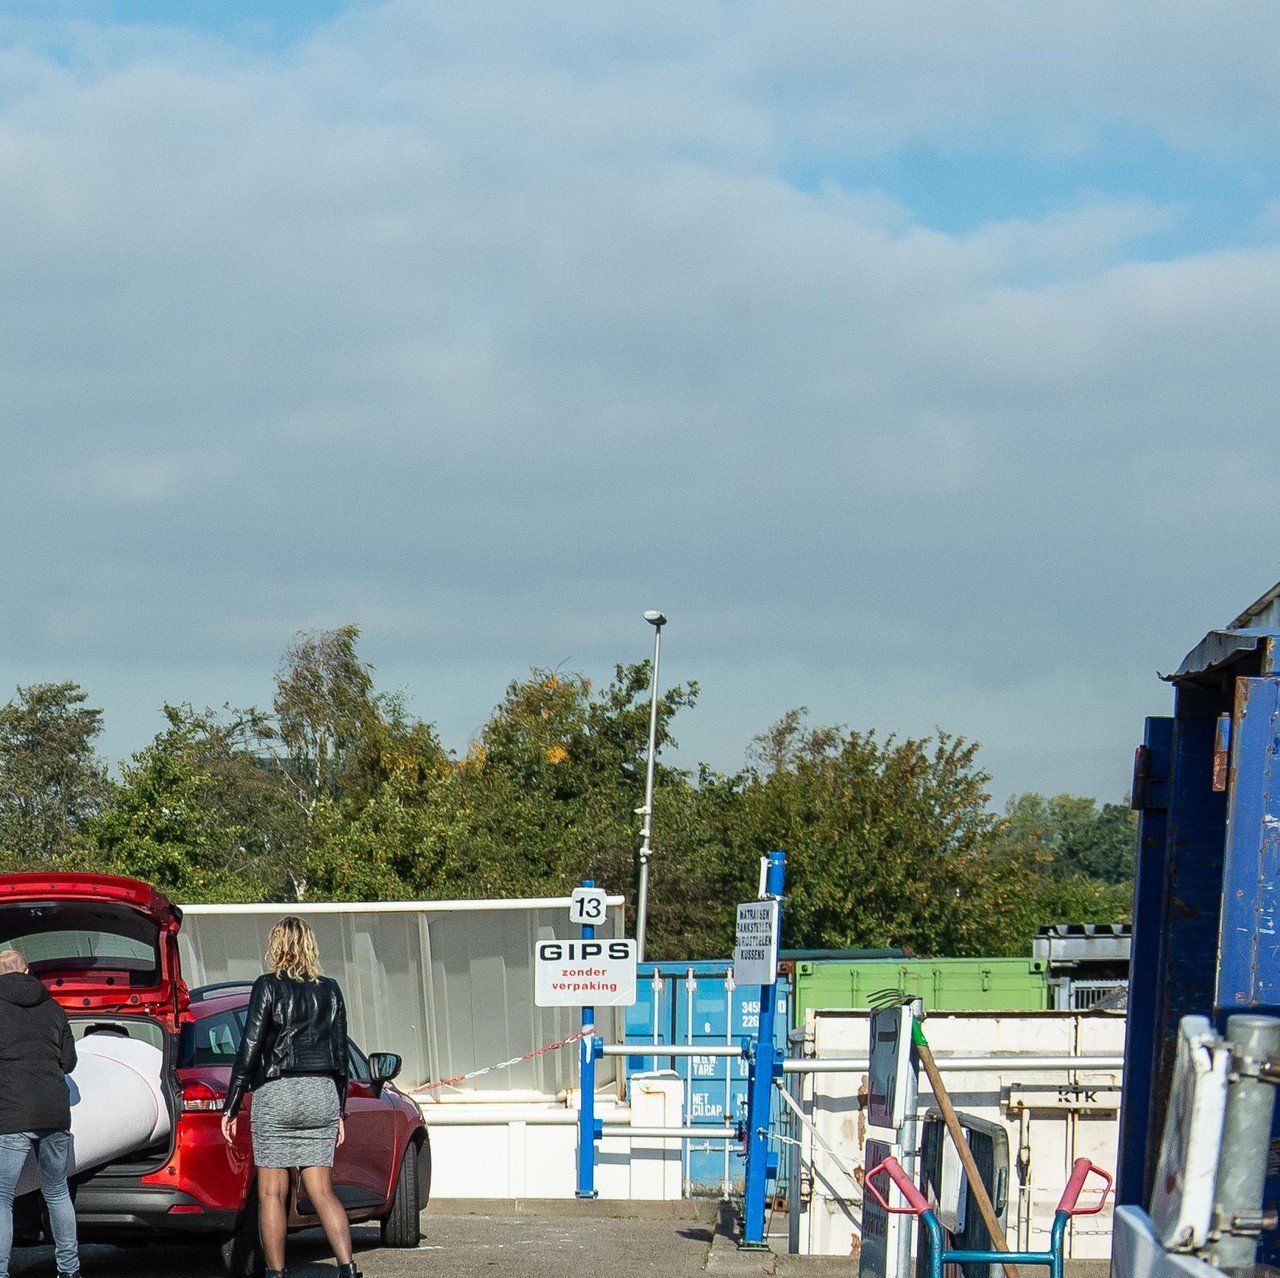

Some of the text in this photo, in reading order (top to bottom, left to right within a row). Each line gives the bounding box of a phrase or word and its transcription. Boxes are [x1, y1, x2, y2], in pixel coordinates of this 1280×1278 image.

[575, 897, 601, 918] 13
[540, 942, 630, 961] GIPS
[740, 949, 765, 960] KUSSENS
[562, 967, 607, 977] zonder
[552, 981, 617, 992] verpaking
[693, 1064, 715, 1076] TARE
[692, 1093, 710, 1105] NET
[1058, 1086, 1098, 1103] KTK
